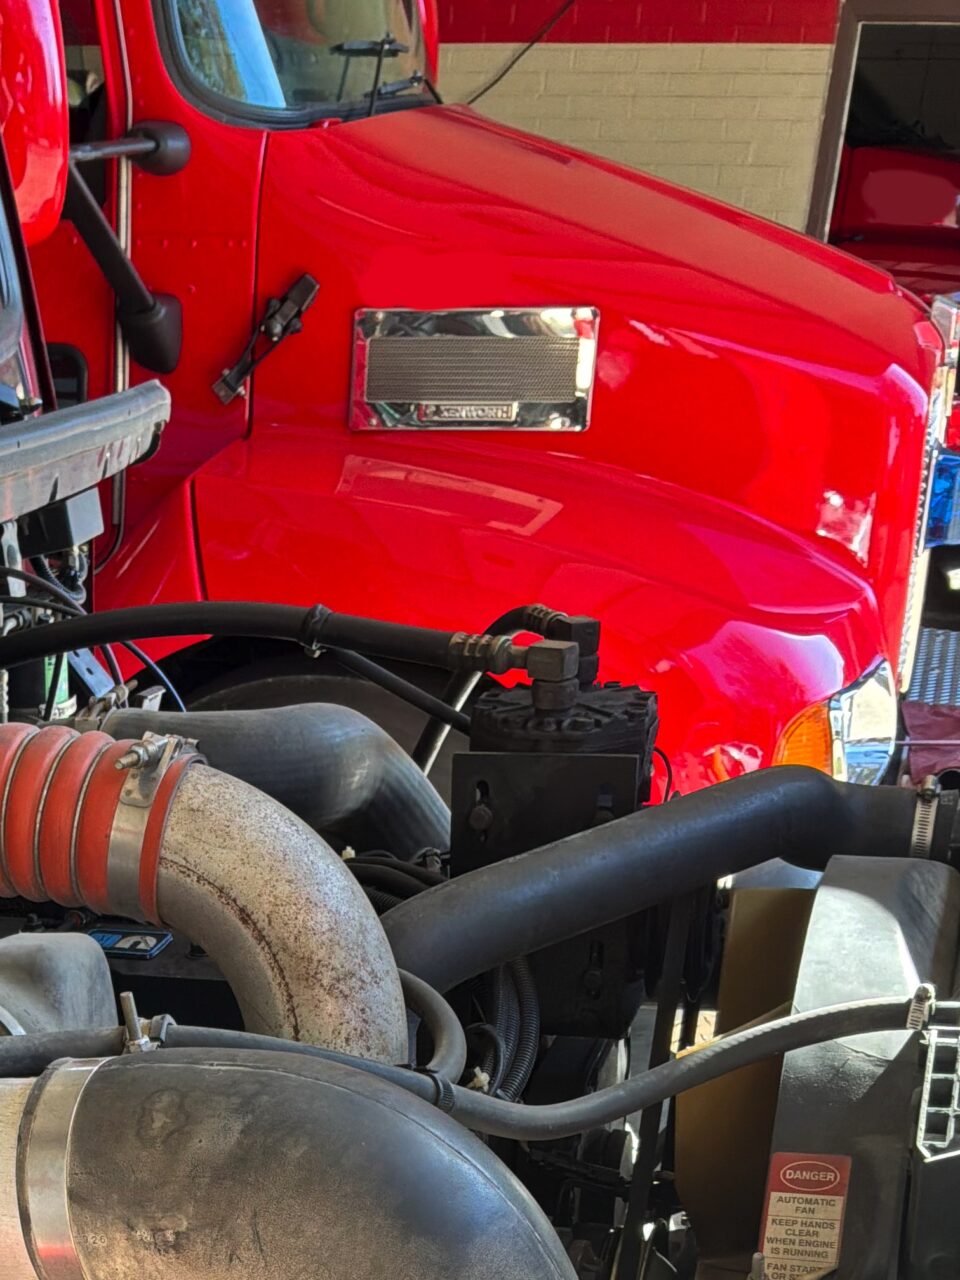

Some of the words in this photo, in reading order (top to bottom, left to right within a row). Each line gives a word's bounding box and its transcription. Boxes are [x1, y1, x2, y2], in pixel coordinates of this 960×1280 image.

[440, 405, 512, 419] KENWORTH
[785, 1169, 836, 1182] DANGER
[776, 1195, 837, 1207] AUTOMATIC
[795, 1206, 816, 1215] FAN
[770, 1218, 799, 1227] KEEP
[800, 1219, 837, 1230] HANDS
[784, 1228, 820, 1238] CLEAR
[766, 1236, 797, 1246] WHEN
[798, 1240, 837, 1250] ENGINE
[770, 1247, 781, 1255] IS
[782, 1248, 830, 1259] RUNNING
[766, 1262, 788, 1271] FAN
[770, 1272, 787, 1280] OR
